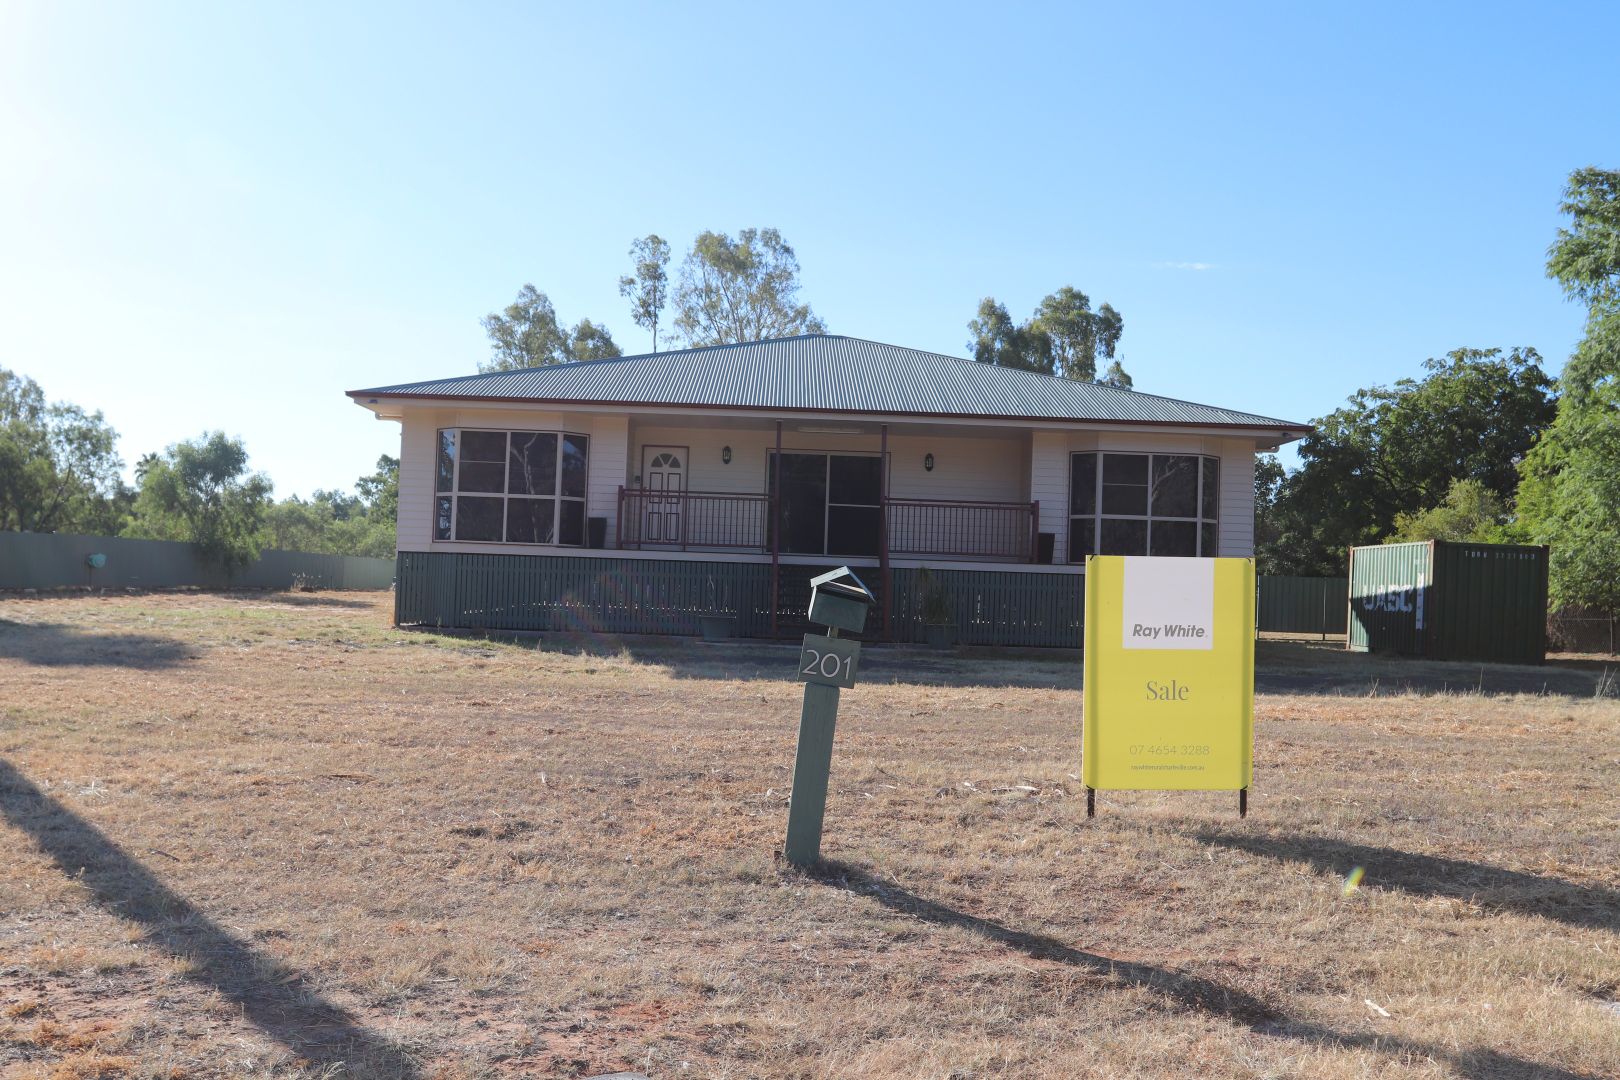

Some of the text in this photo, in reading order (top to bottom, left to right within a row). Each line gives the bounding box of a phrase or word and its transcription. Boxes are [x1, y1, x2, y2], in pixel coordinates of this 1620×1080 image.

[1132, 623, 1205, 640] Ray White
[802, 649, 852, 680] 201
[1146, 680, 1190, 701] Sale
[1129, 745, 1210, 756] 07 4654 3288
